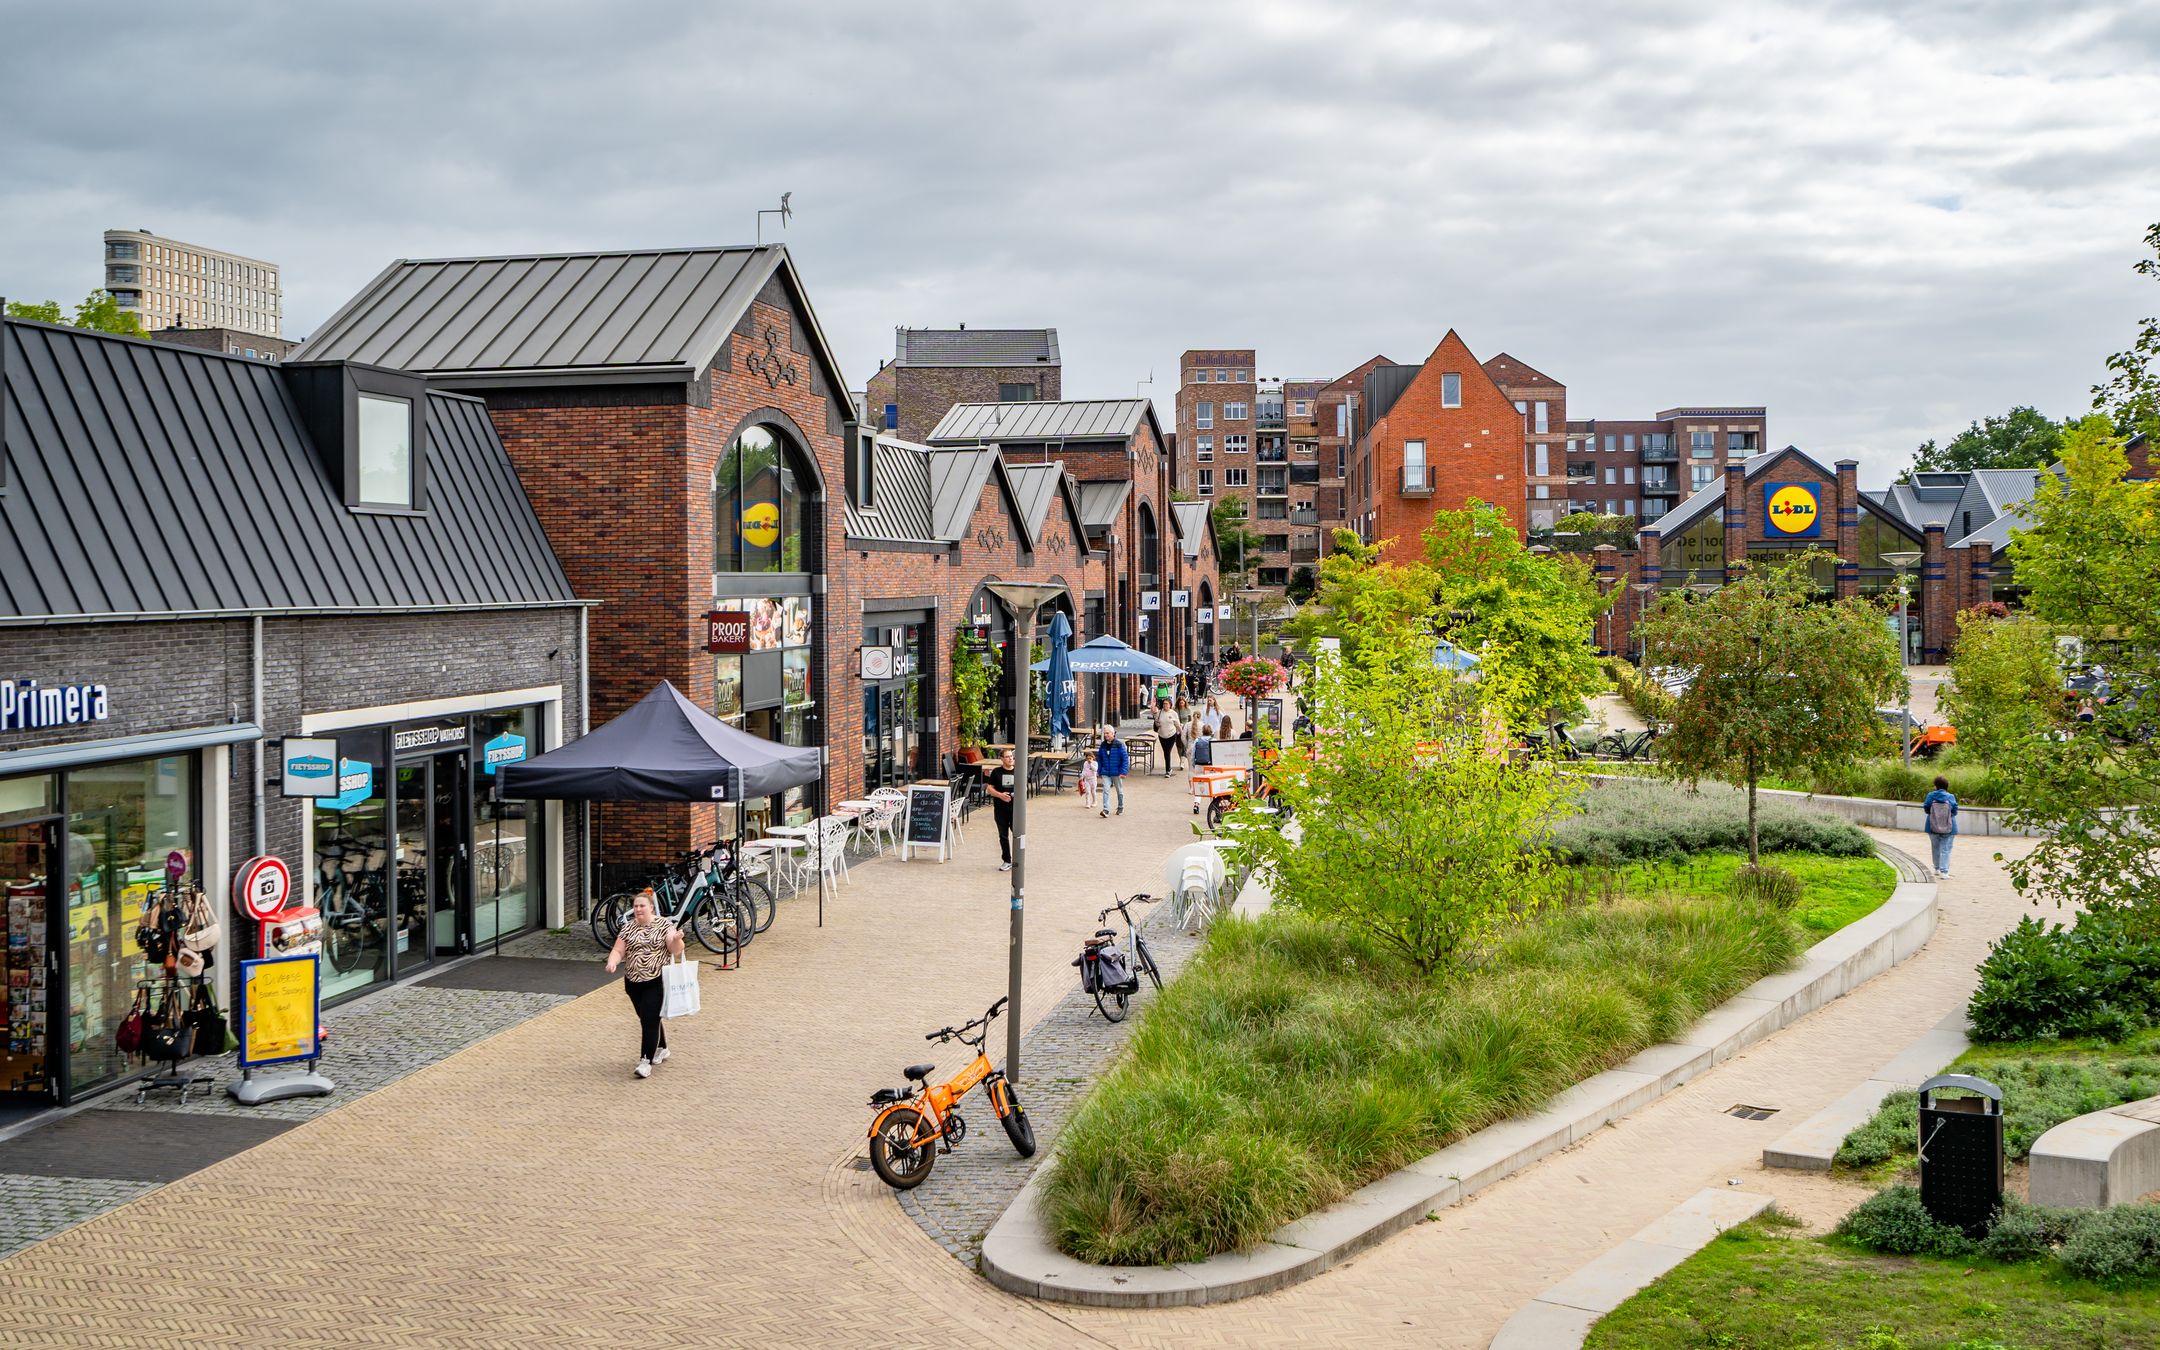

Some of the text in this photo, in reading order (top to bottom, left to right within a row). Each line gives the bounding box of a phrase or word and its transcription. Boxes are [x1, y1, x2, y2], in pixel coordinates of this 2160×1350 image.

[1688, 552, 1718, 562] voor
[712, 622, 747, 636] PROOF
[712, 635, 746, 643] BAKERY
[1070, 660, 1130, 669] PERONI
[0, 679, 108, 731] Primera
[395, 727, 439, 749] FIETSSHOP
[487, 745, 524, 764] FIETSSHOP
[290, 763, 331, 771] FIETSSHOP
